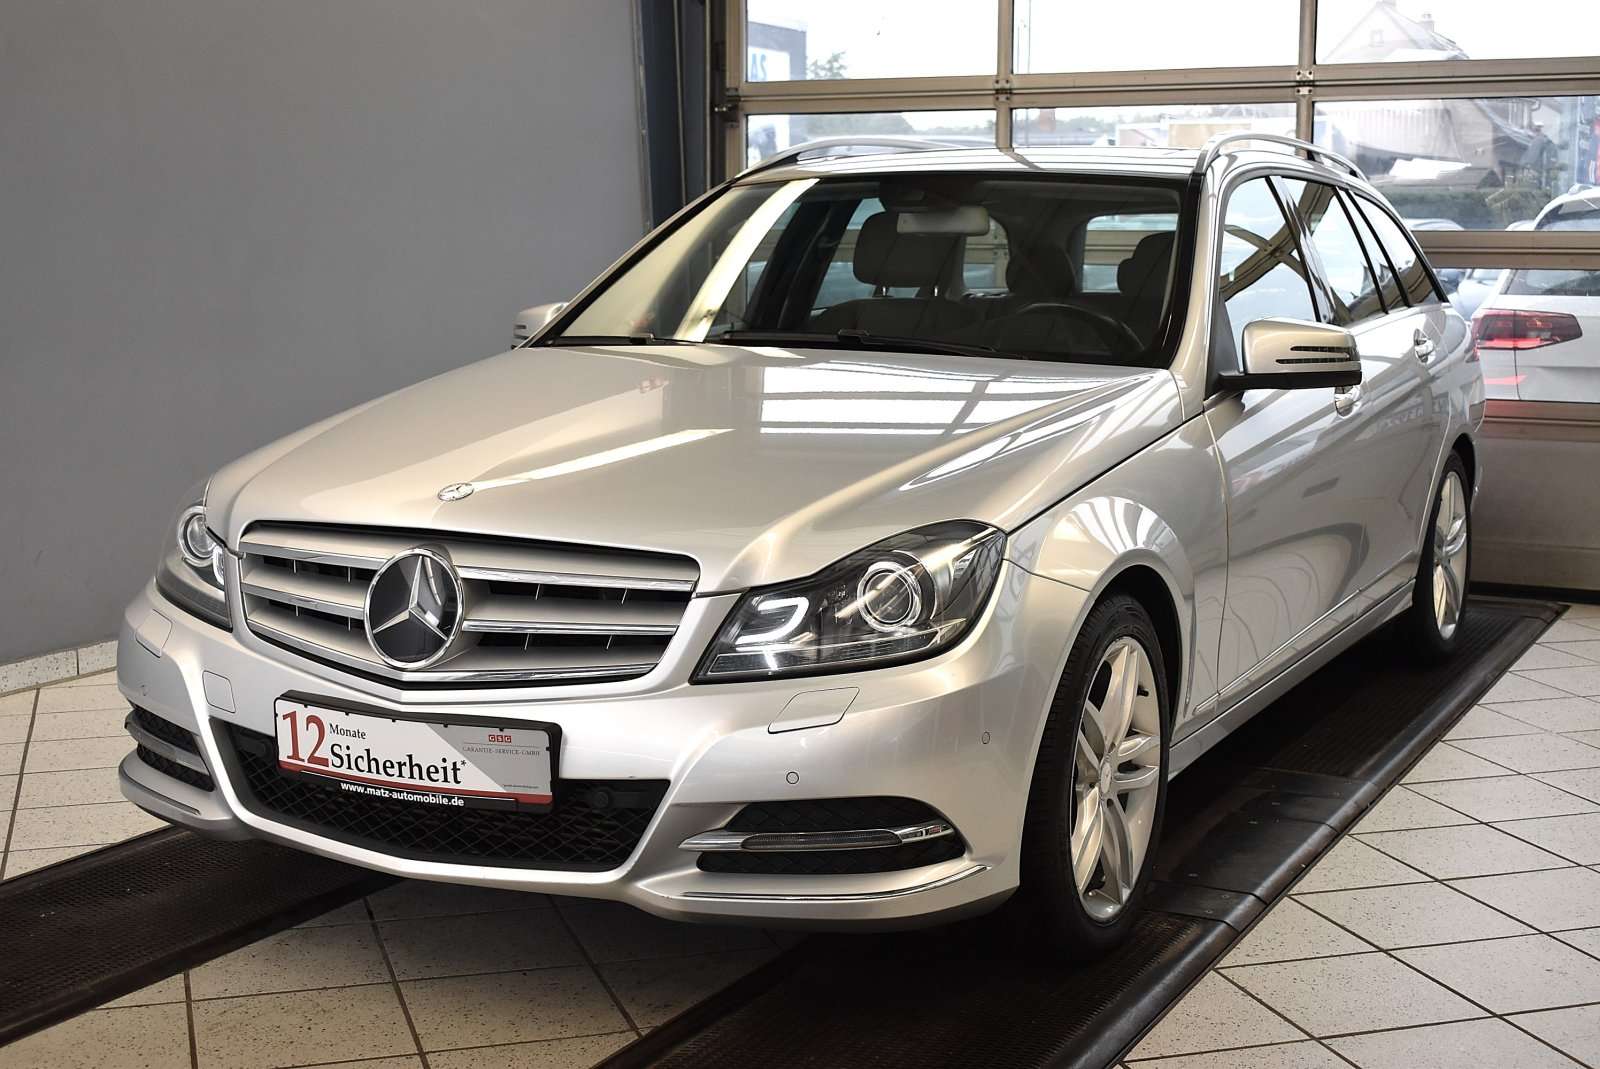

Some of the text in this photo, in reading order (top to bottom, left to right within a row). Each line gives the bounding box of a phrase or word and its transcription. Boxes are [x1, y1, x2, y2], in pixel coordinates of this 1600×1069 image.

[282, 710, 329, 768] 12
[329, 723, 367, 740] Monate
[488, 734, 512, 745] GSG
[340, 781, 465, 807] www.matz-automobile.de
